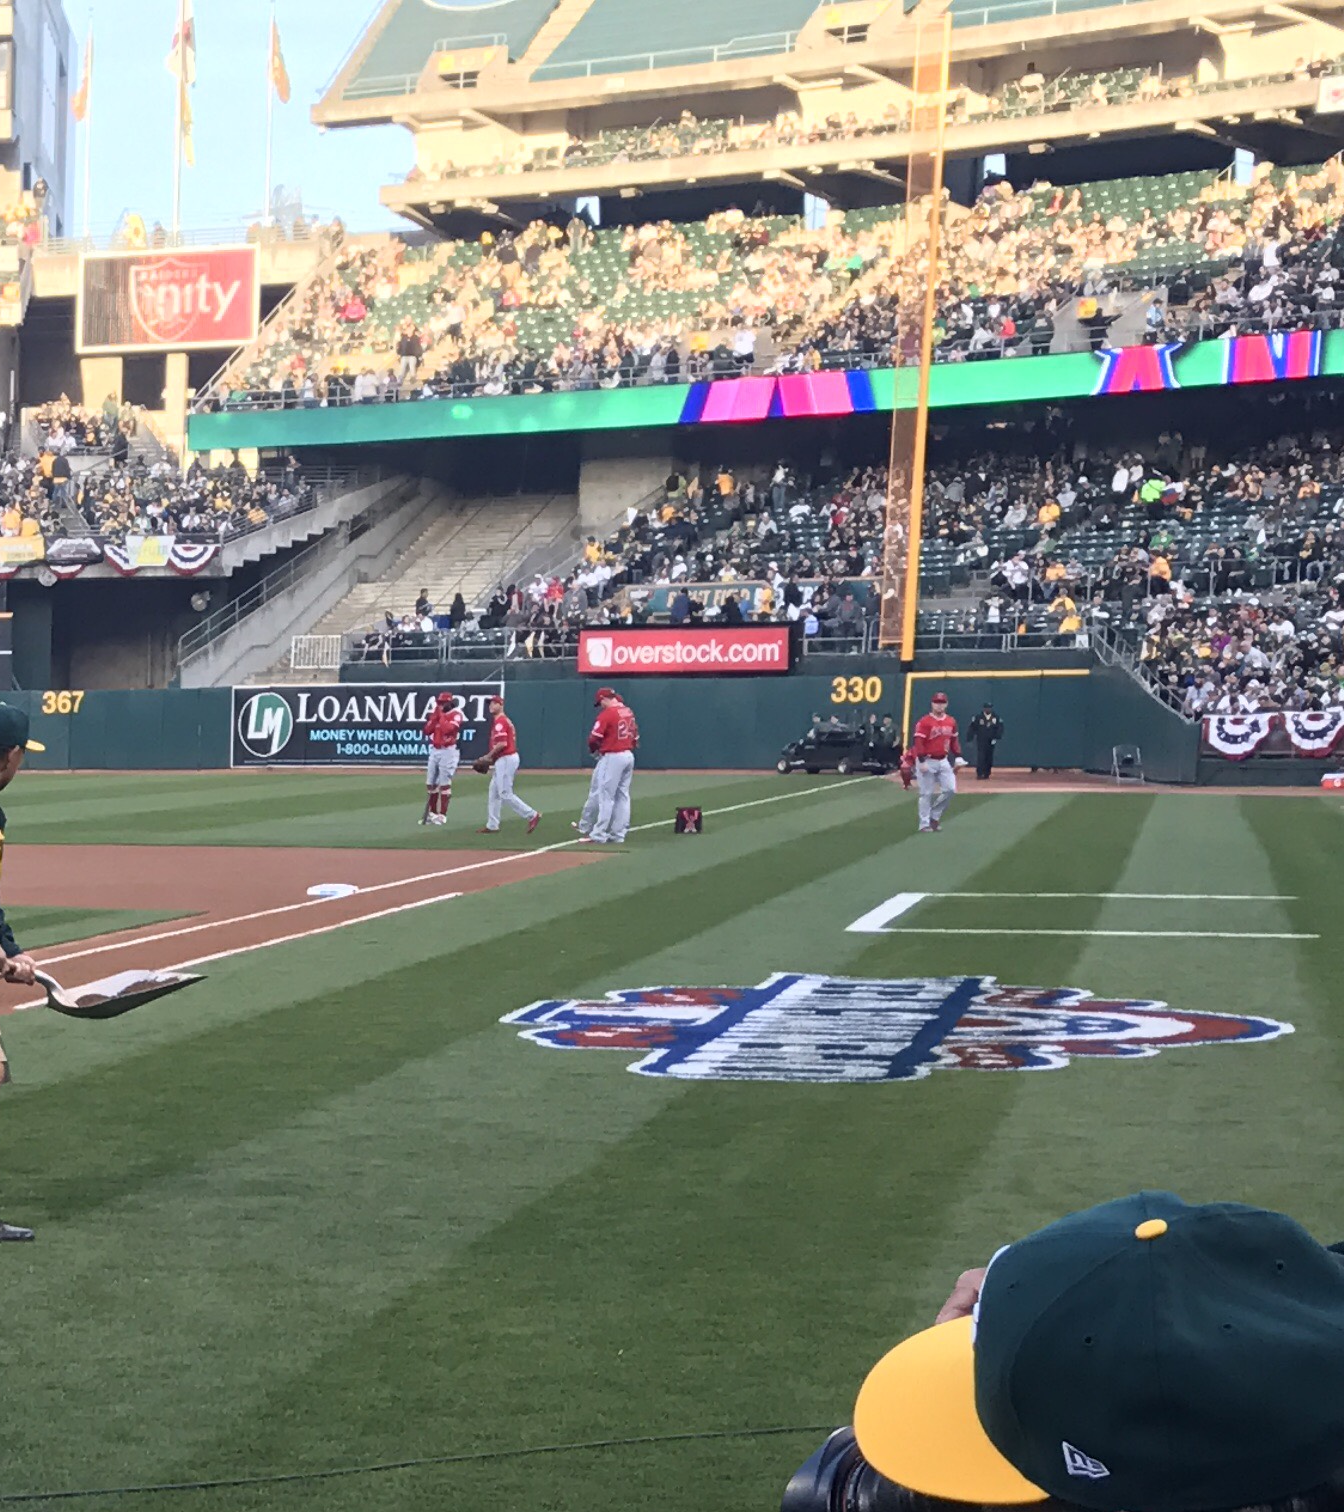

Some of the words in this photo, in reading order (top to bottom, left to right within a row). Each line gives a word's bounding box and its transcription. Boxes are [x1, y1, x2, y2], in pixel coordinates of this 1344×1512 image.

[614, 639, 780, 665] overstock.com
[41, 690, 85, 715] 367
[831, 676, 882, 704] 330
[310, 729, 353, 742] MONEY
[357, 729, 392, 742] WHEN
[395, 728, 422, 742] YOU
[463, 729, 476, 741] IT
[336, 743, 433, 756] 1-800-LOANMA
